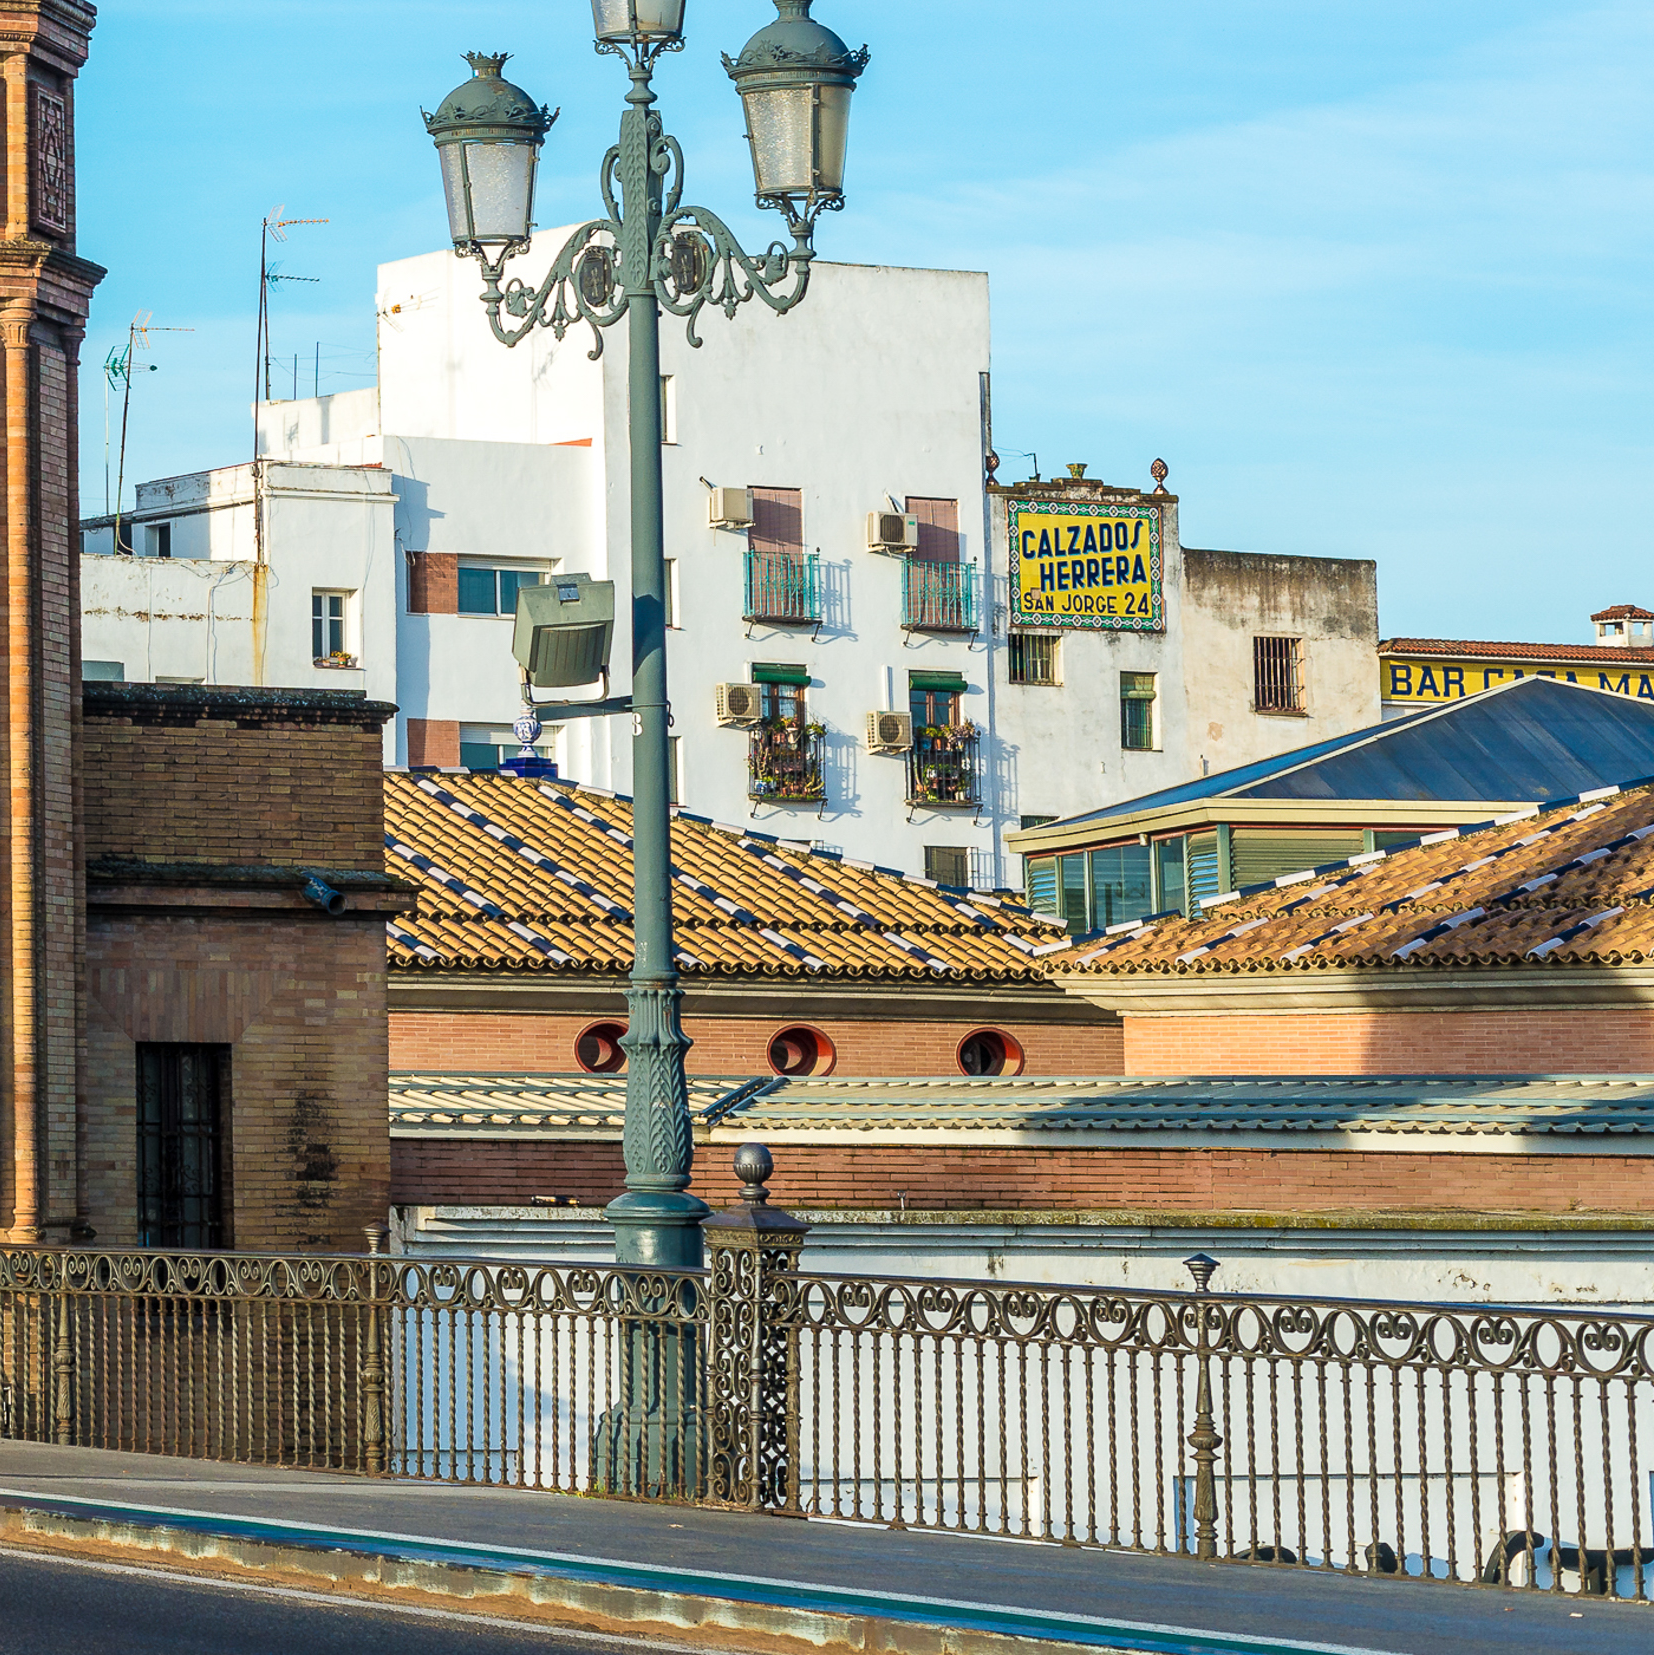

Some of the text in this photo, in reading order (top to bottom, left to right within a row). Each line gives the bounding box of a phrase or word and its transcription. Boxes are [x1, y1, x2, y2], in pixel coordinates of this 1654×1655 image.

[1022, 520, 1144, 560] CALZADOS
[1040, 554, 1147, 593] HERRERA
[1024, 592, 1149, 615] SAN JORGE 24
[1390, 664, 1465, 698] BAR
